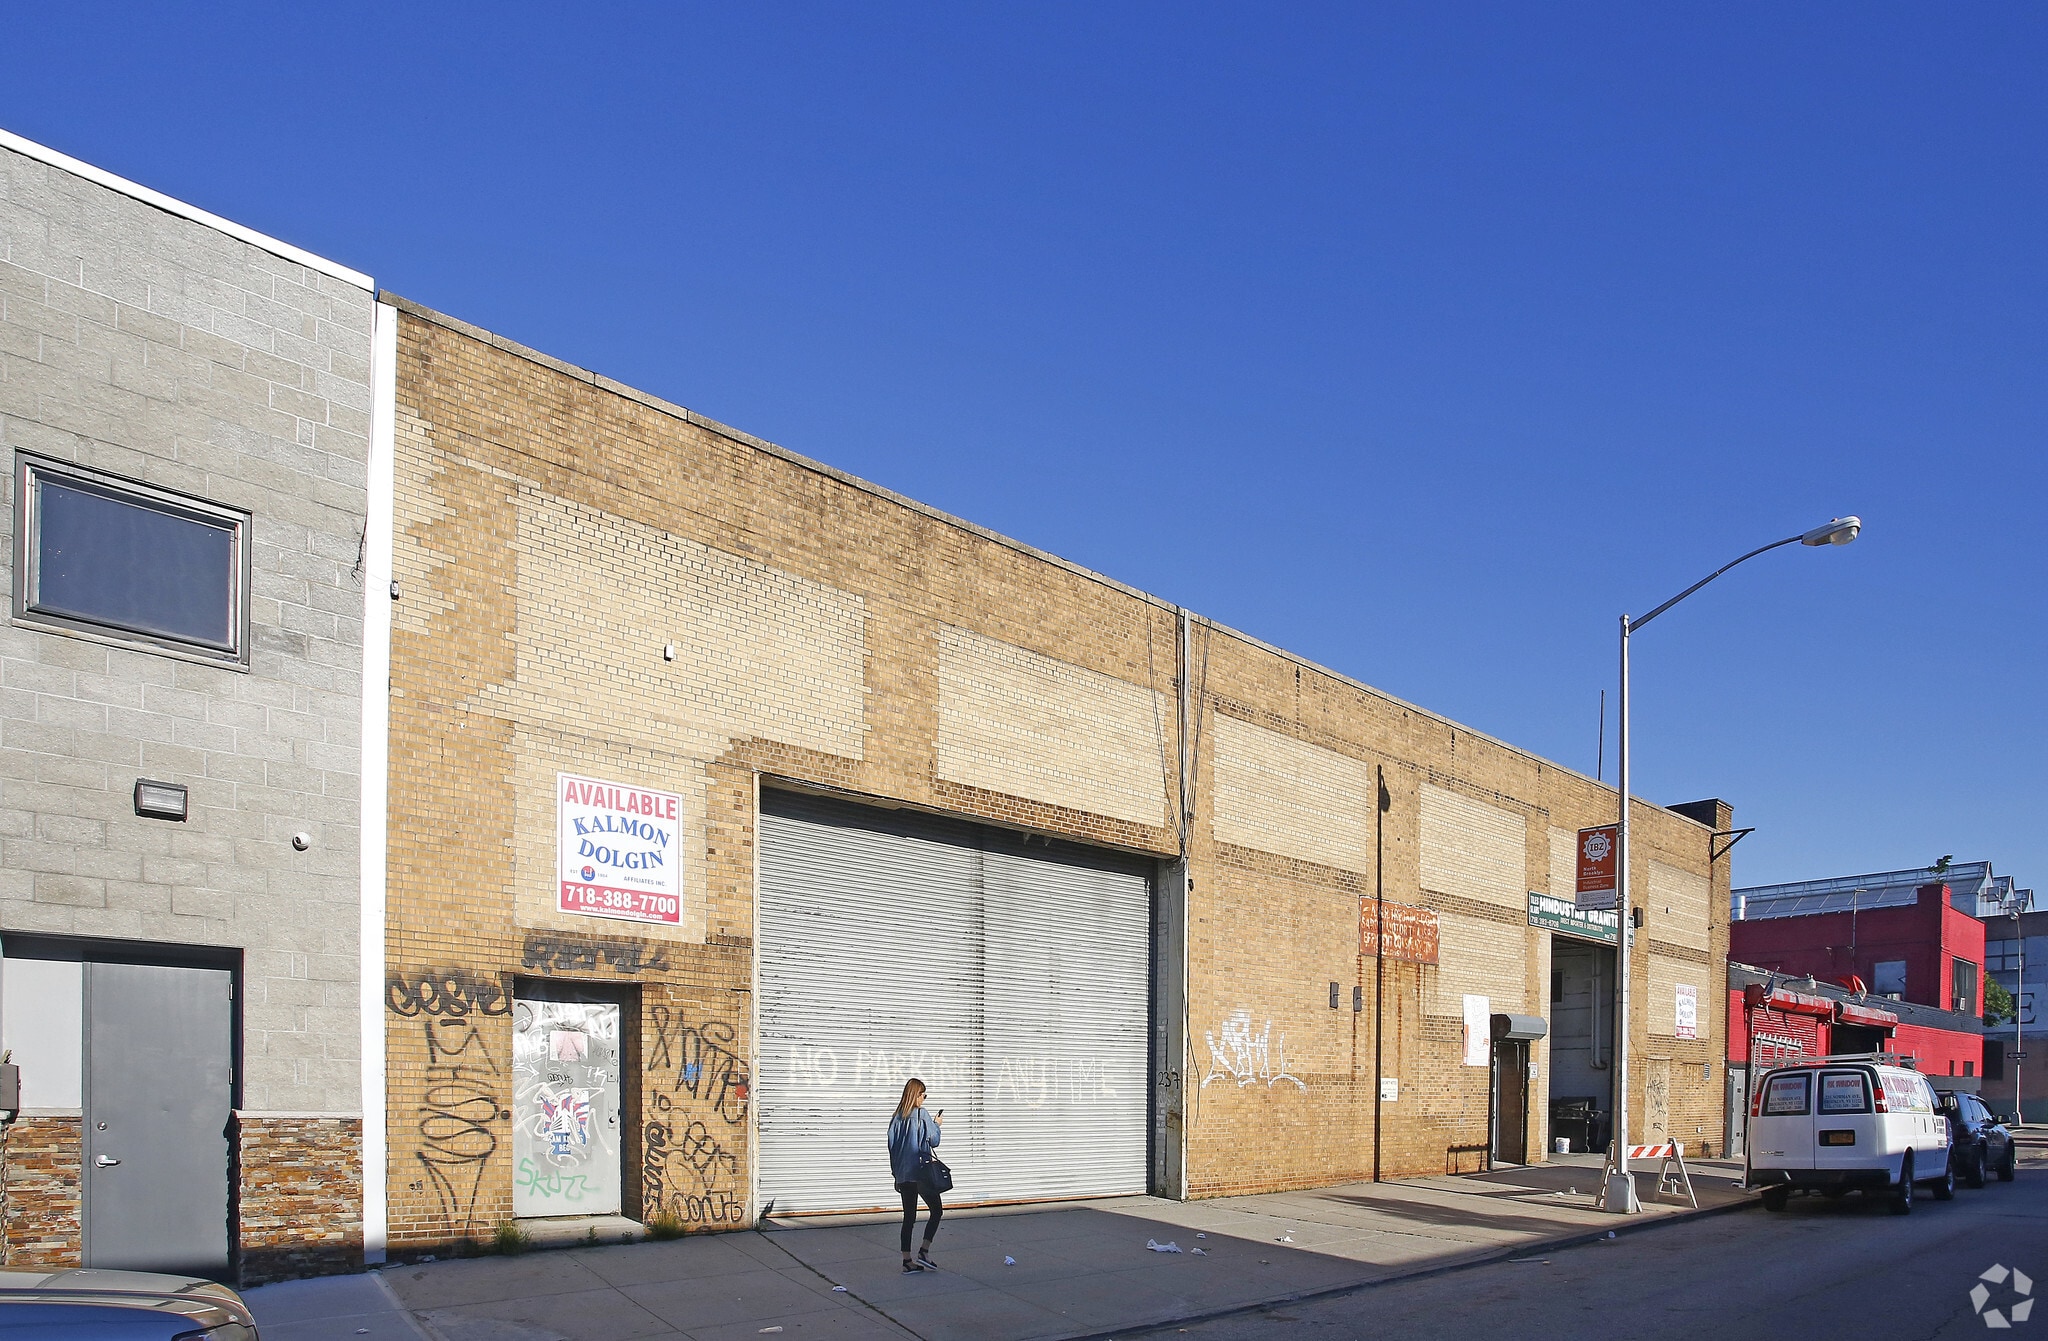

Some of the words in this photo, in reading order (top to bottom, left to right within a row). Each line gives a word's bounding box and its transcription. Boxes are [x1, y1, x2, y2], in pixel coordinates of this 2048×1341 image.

[565, 781, 676, 820] AVAILABLE
[573, 815, 671, 848] KALMON
[578, 838, 664, 869] DOLGIN
[1590, 843, 1604, 851] IBZ
[624, 876, 654, 885] AFFILIATES
[565, 885, 676, 914] 718-388-7700
[1540, 896, 1585, 920] HINDUSTAN
[580, 905, 664, 920] www.kalmondolgin.com
[788, 1046, 838, 1085] NO
[1158, 1071, 1180, 1089] 237
[1780, 1082, 1802, 1090] WINDOW
[1836, 1079, 1860, 1088] WINDOW
